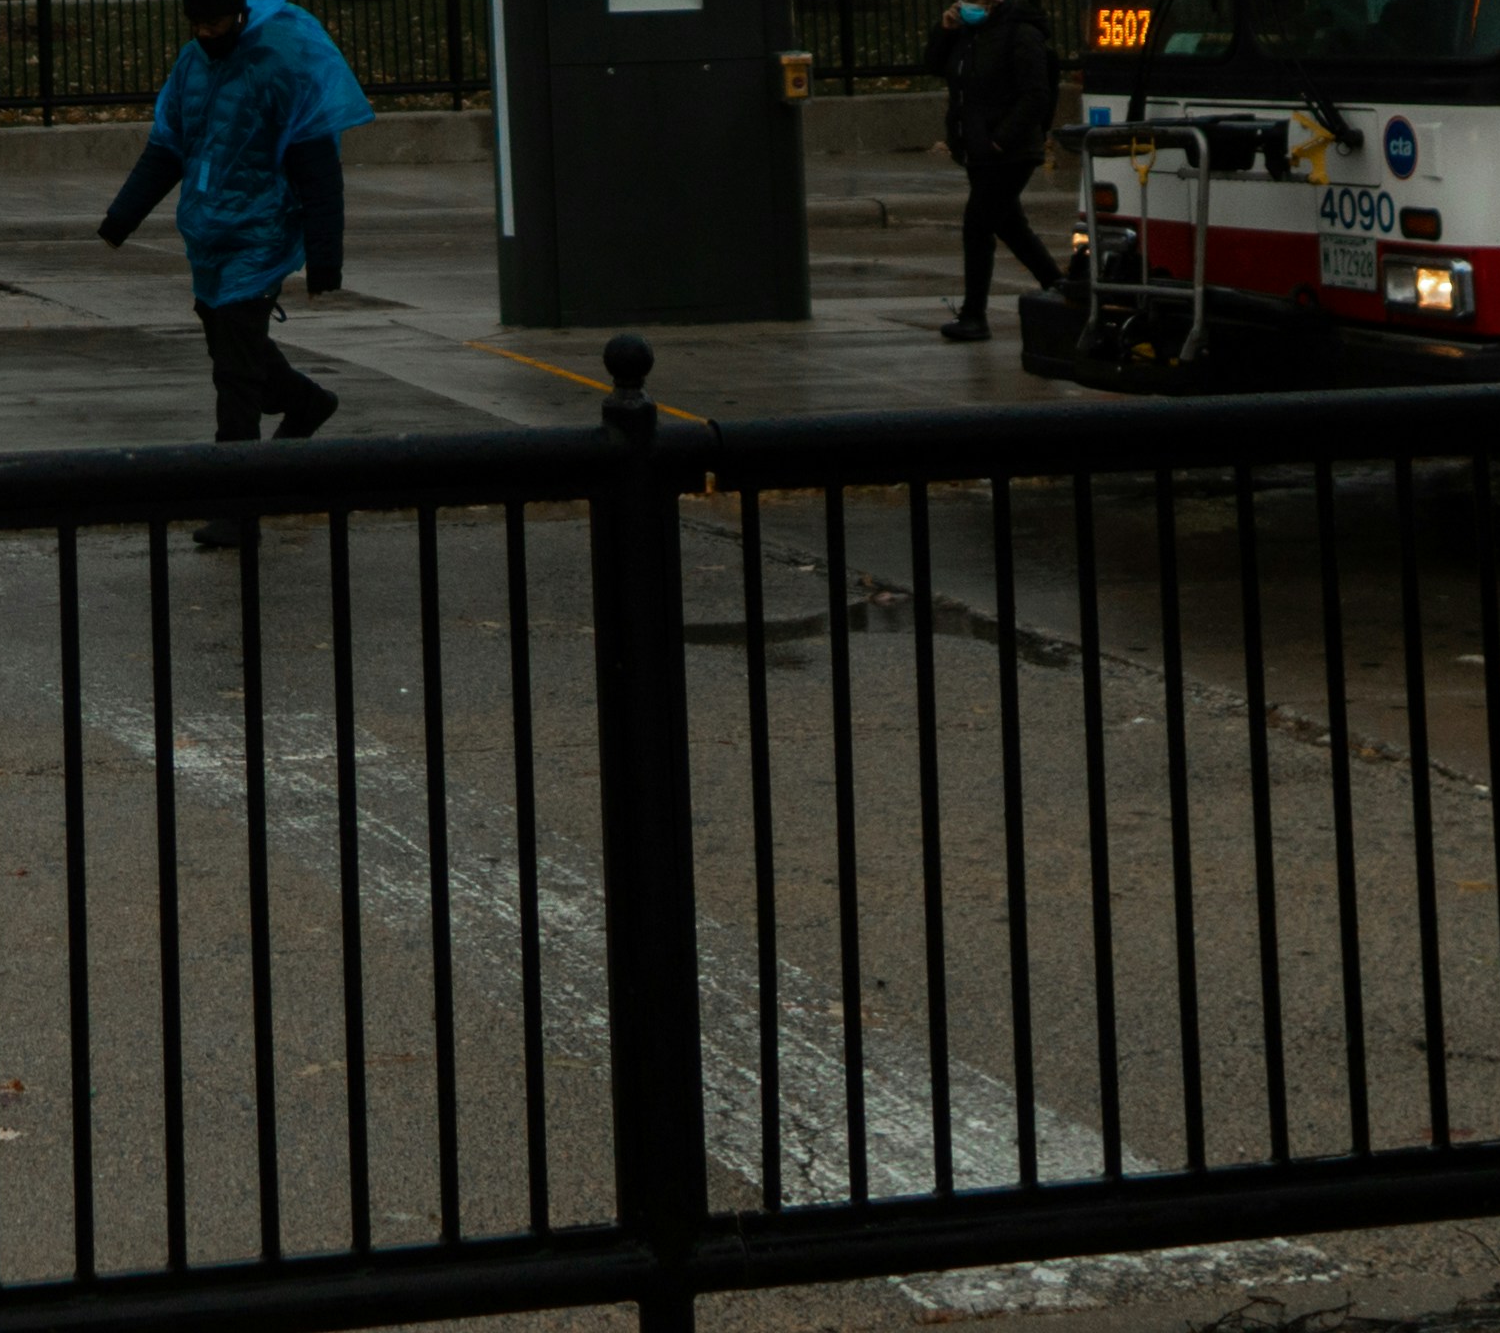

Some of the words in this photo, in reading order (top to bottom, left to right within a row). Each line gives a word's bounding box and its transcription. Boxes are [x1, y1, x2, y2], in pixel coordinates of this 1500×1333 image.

[1098, 9, 1151, 47] 5607
[1389, 136, 1413, 157] cta
[1320, 188, 1395, 233] 4090
